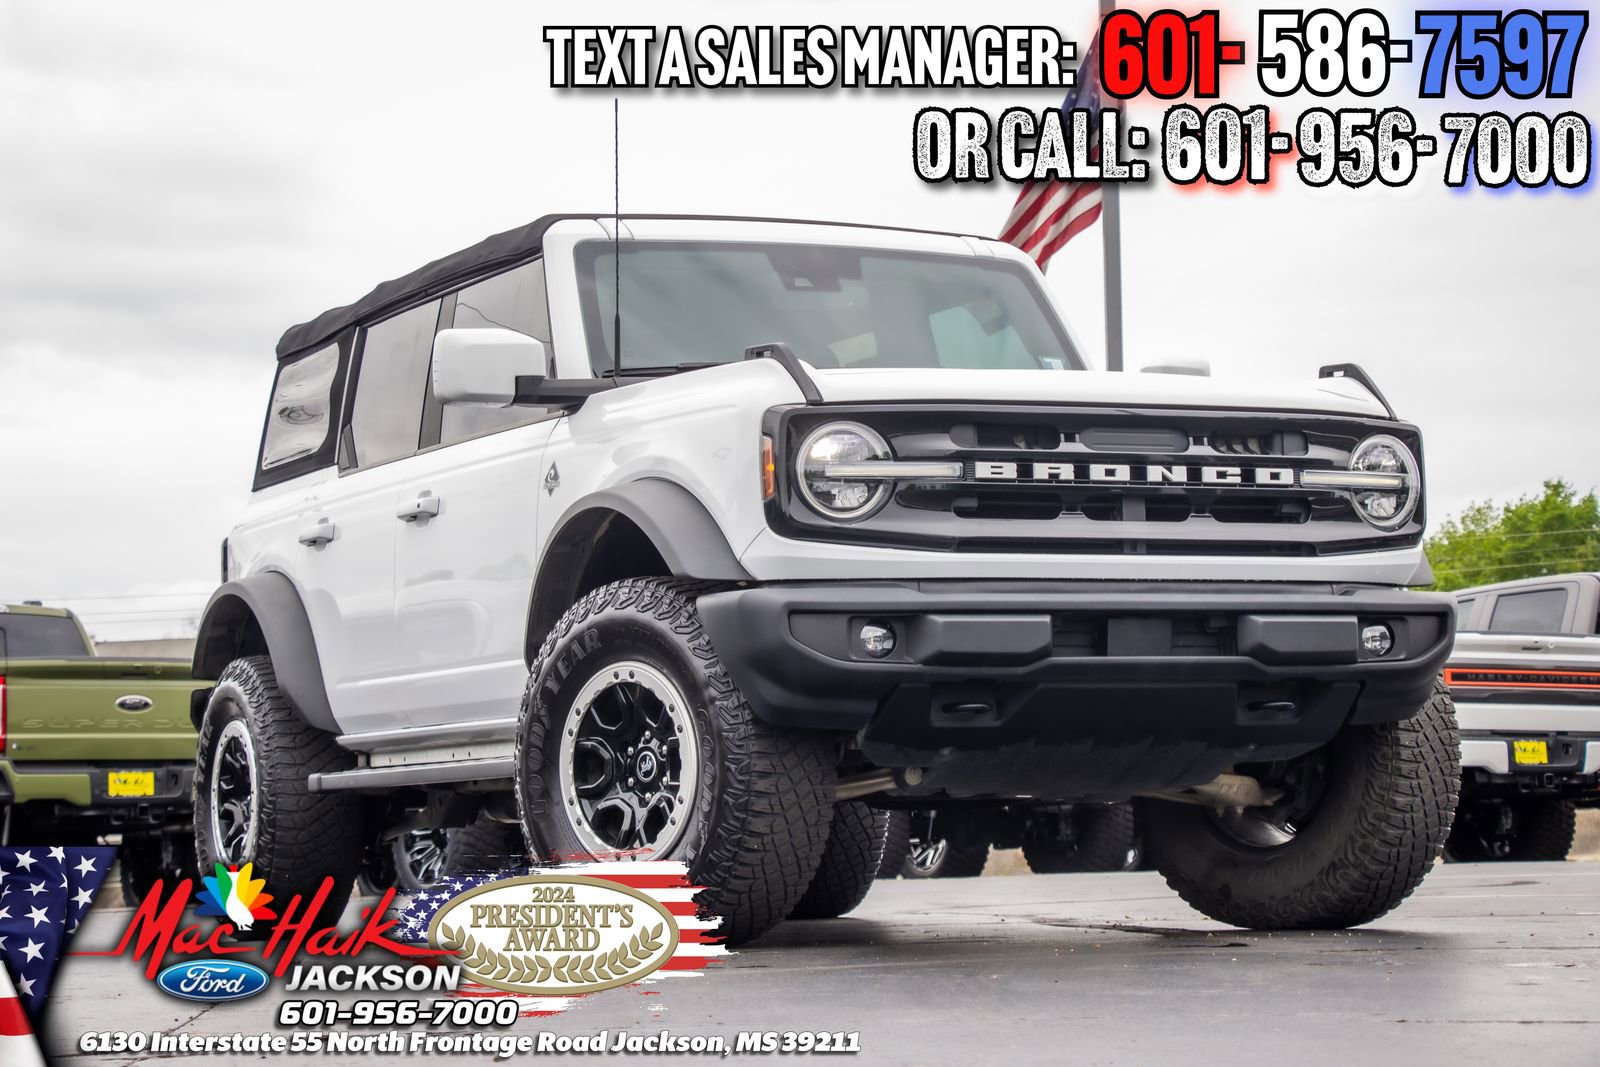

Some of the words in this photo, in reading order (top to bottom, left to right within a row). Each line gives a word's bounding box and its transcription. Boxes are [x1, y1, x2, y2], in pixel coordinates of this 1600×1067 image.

[975, 461, 1294, 485] BRONCO
[545, 628, 602, 695] YEAR
[23, 717, 143, 729] SUPER
